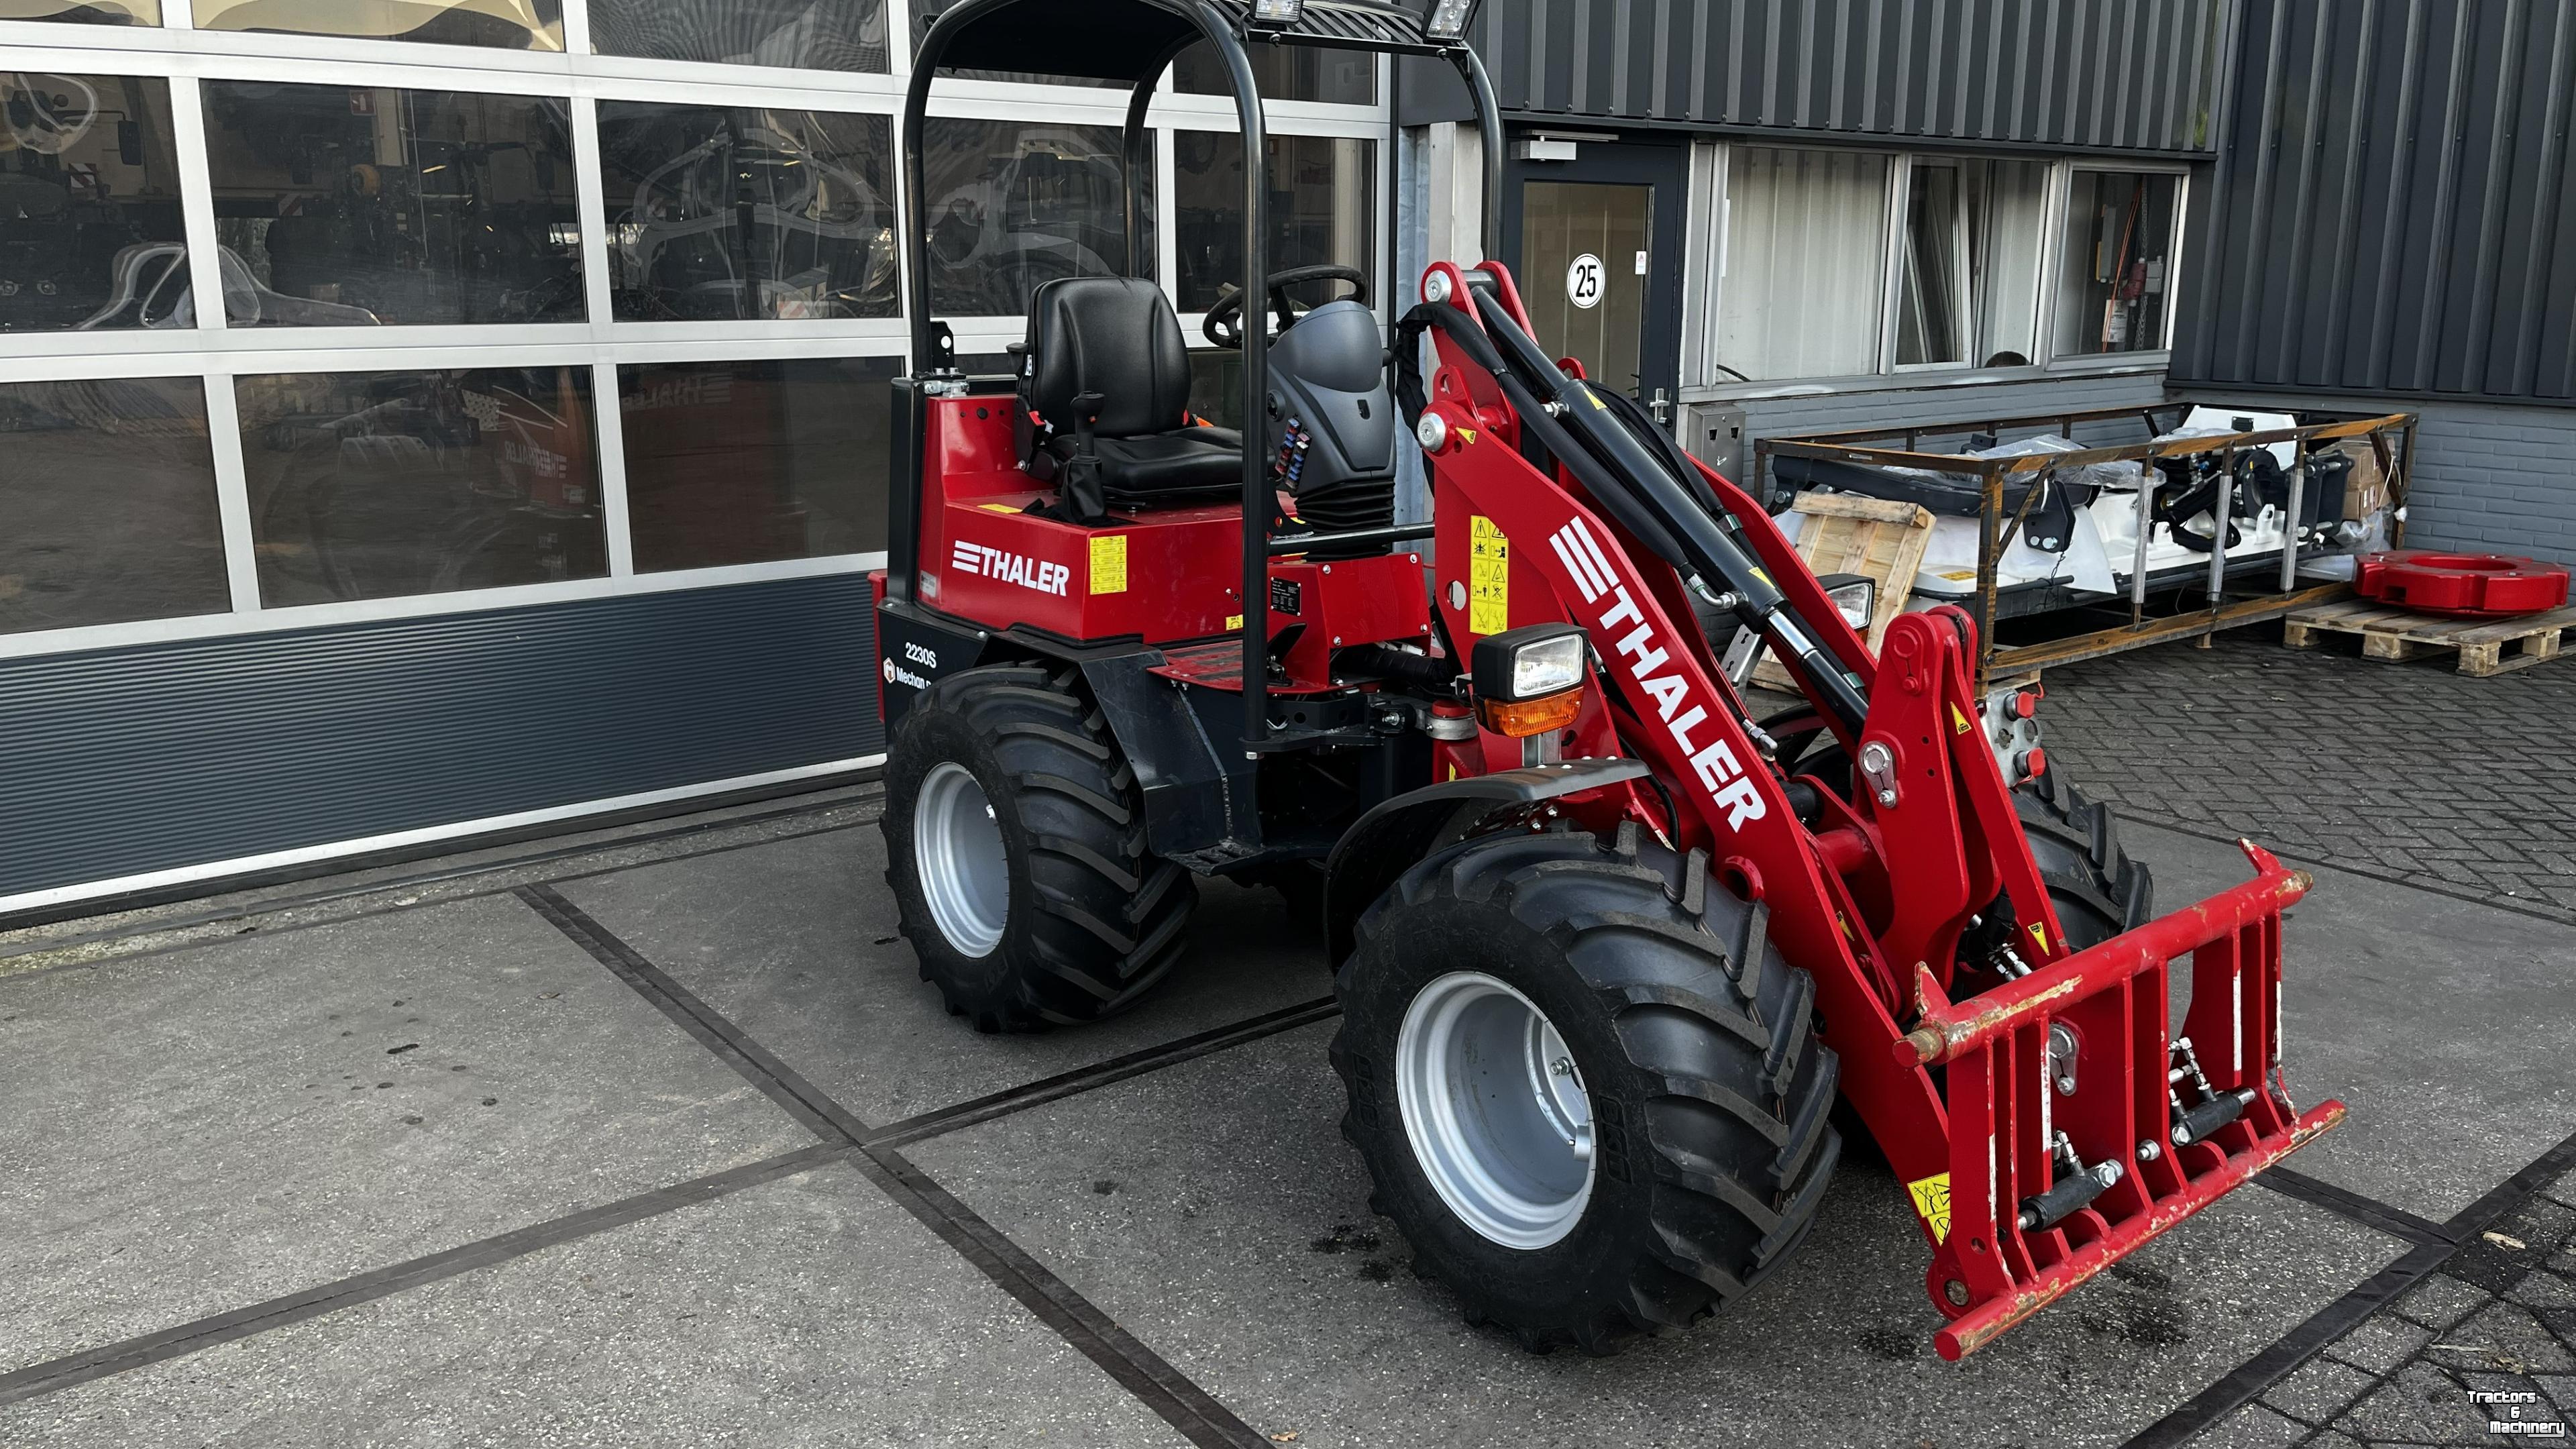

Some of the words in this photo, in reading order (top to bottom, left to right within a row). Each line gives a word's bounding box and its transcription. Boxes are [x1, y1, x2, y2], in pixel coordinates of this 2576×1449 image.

[1576, 264, 1597, 297] 25
[981, 546, 1070, 597] THALER
[905, 641, 937, 669] 2230S
[896, 666, 925, 690] Mechan
[1599, 584, 1767, 834] THALER
[1599, 1094, 1633, 1184] BKT
